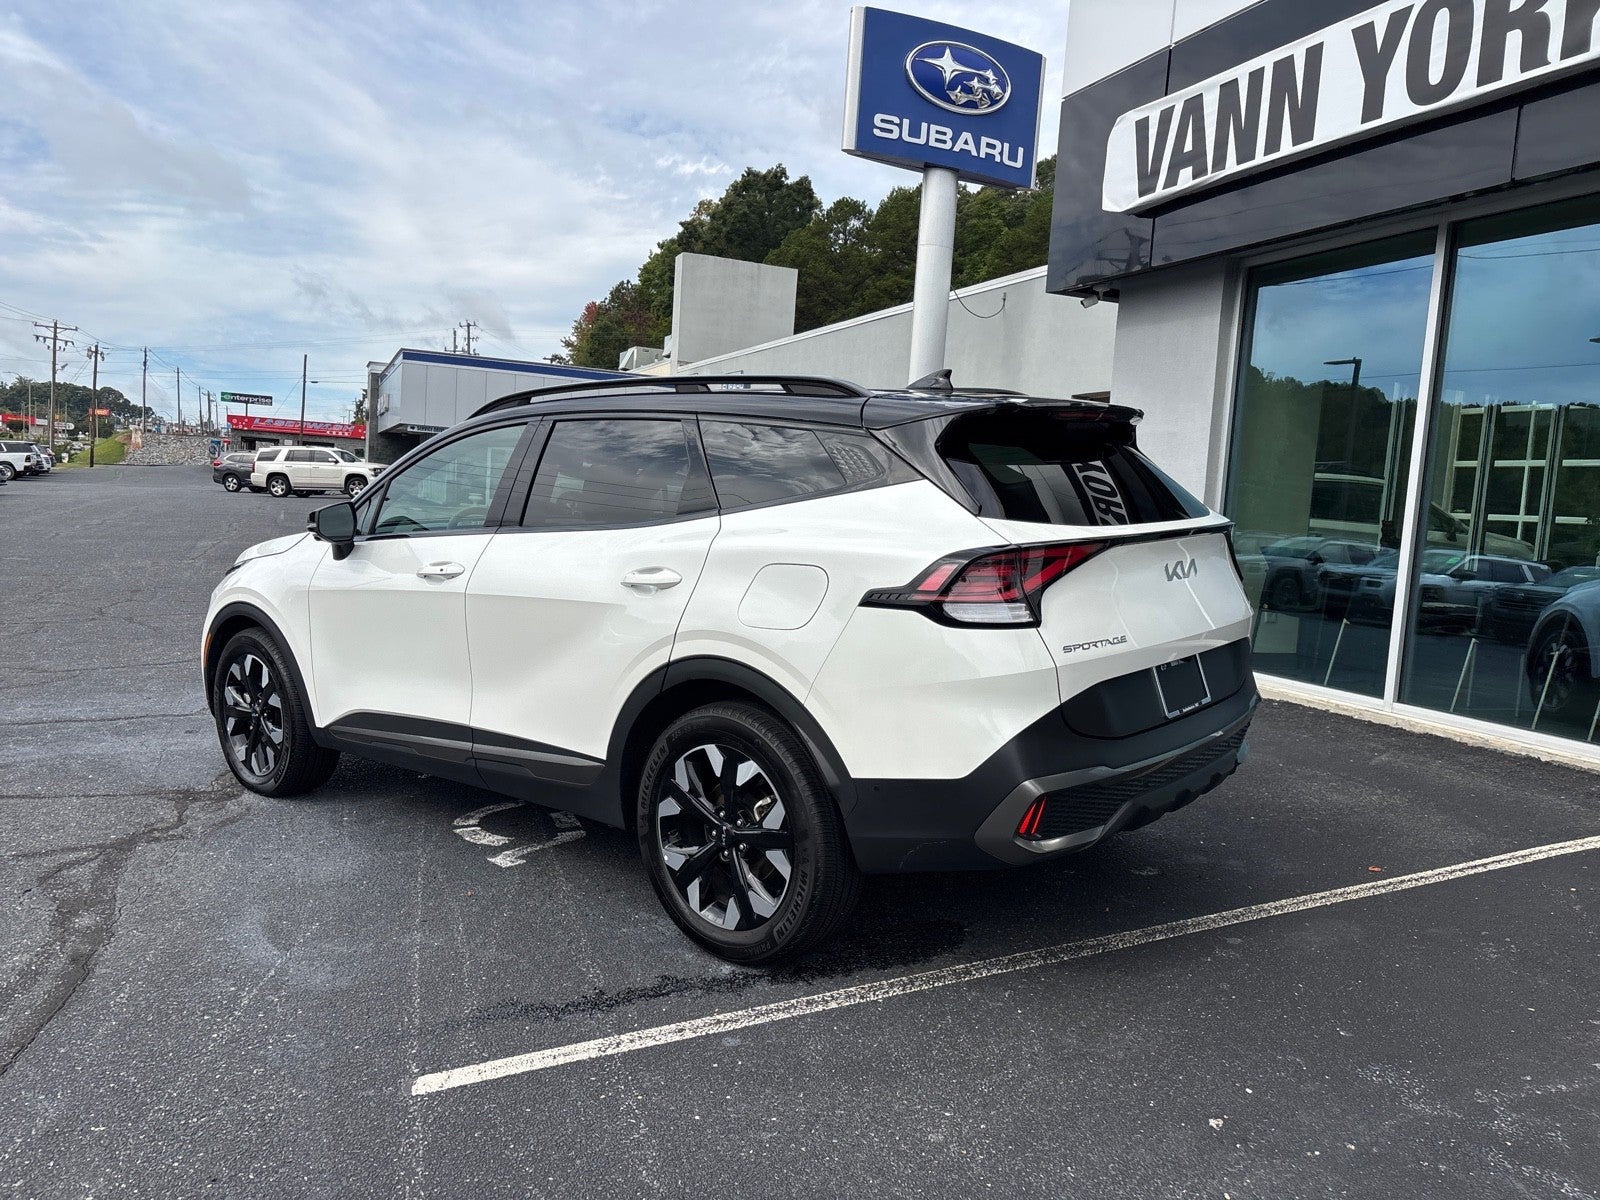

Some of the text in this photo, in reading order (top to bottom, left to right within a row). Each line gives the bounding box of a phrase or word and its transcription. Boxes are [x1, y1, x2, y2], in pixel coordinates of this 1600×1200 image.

[872, 112, 1024, 169] SUBARU
[1134, 41, 1325, 199] VANN
[222, 393, 272, 403] enterprise
[1164, 558, 1198, 582] KIA
[1062, 635, 1128, 654] SPORTAGE
[641, 744, 667, 810] MICHELIN
[776, 870, 808, 939] MICHELIN
